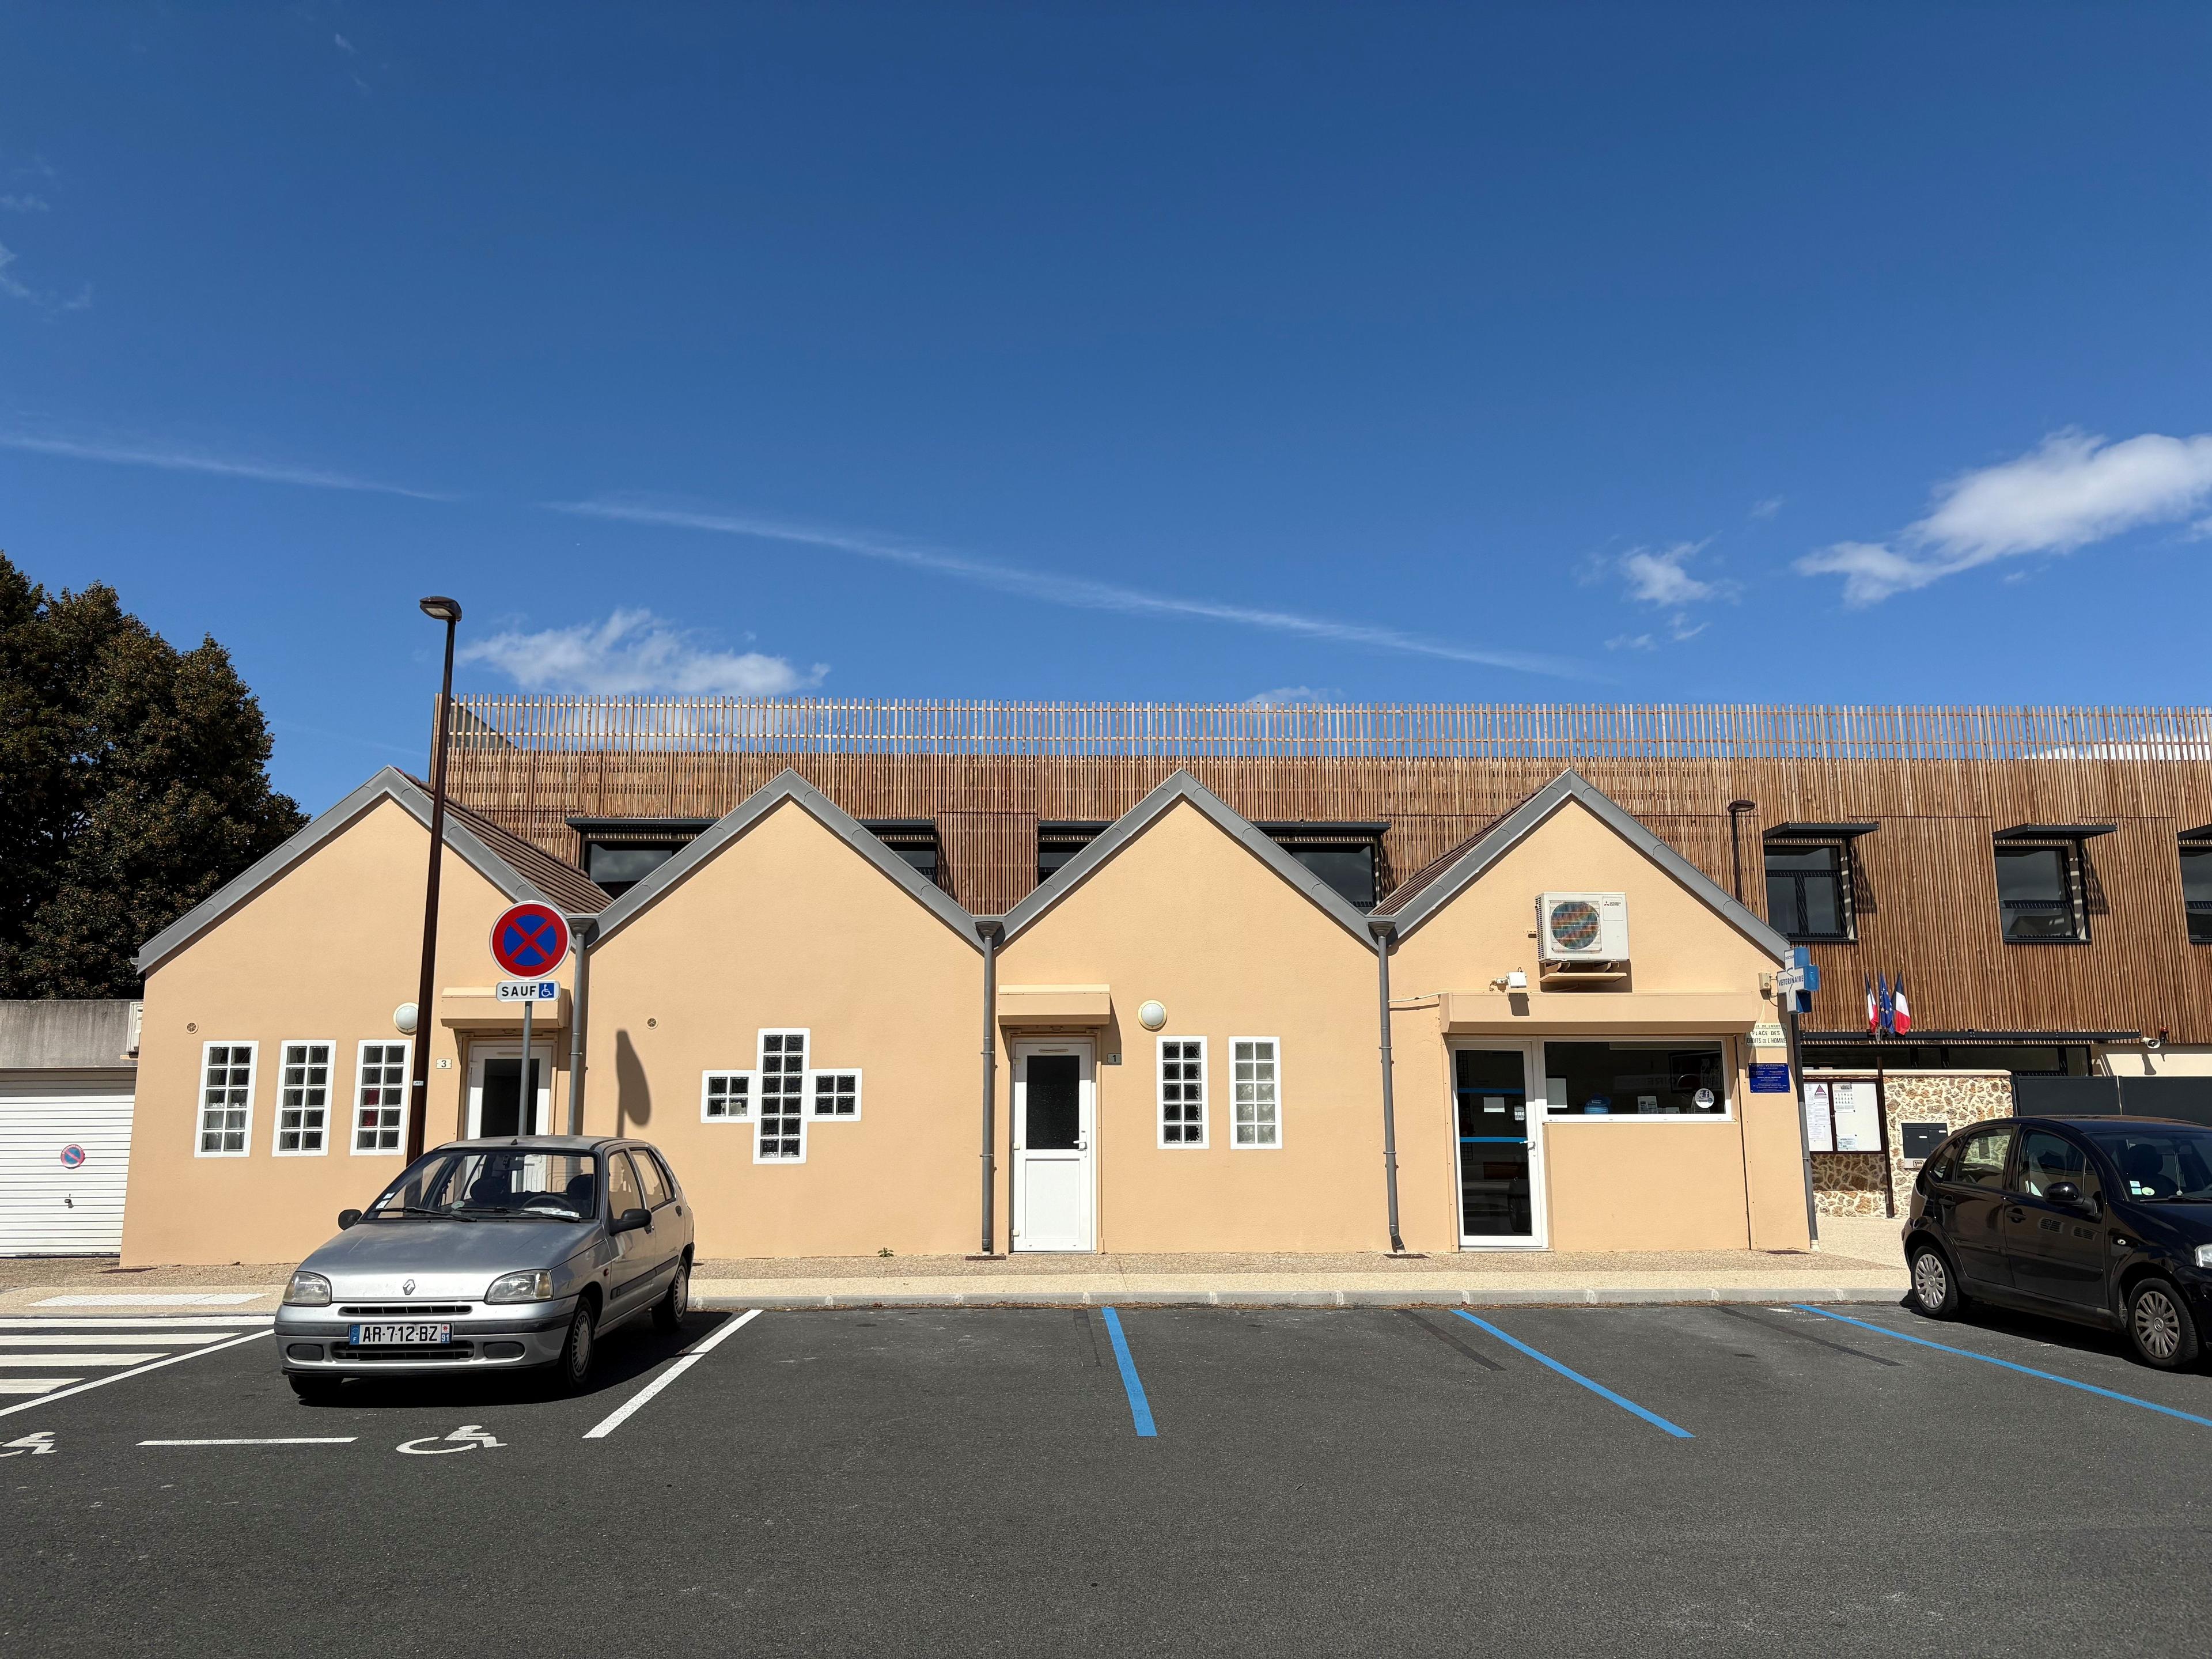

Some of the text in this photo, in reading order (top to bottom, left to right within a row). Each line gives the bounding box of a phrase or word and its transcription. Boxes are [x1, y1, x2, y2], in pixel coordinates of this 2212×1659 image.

[1778, 975, 1804, 986] VETERINAIRE
[502, 986, 536, 997] SAUF
[1112, 1054, 1116, 1062] 1
[362, 1326, 438, 1342] AR-712-BZ
